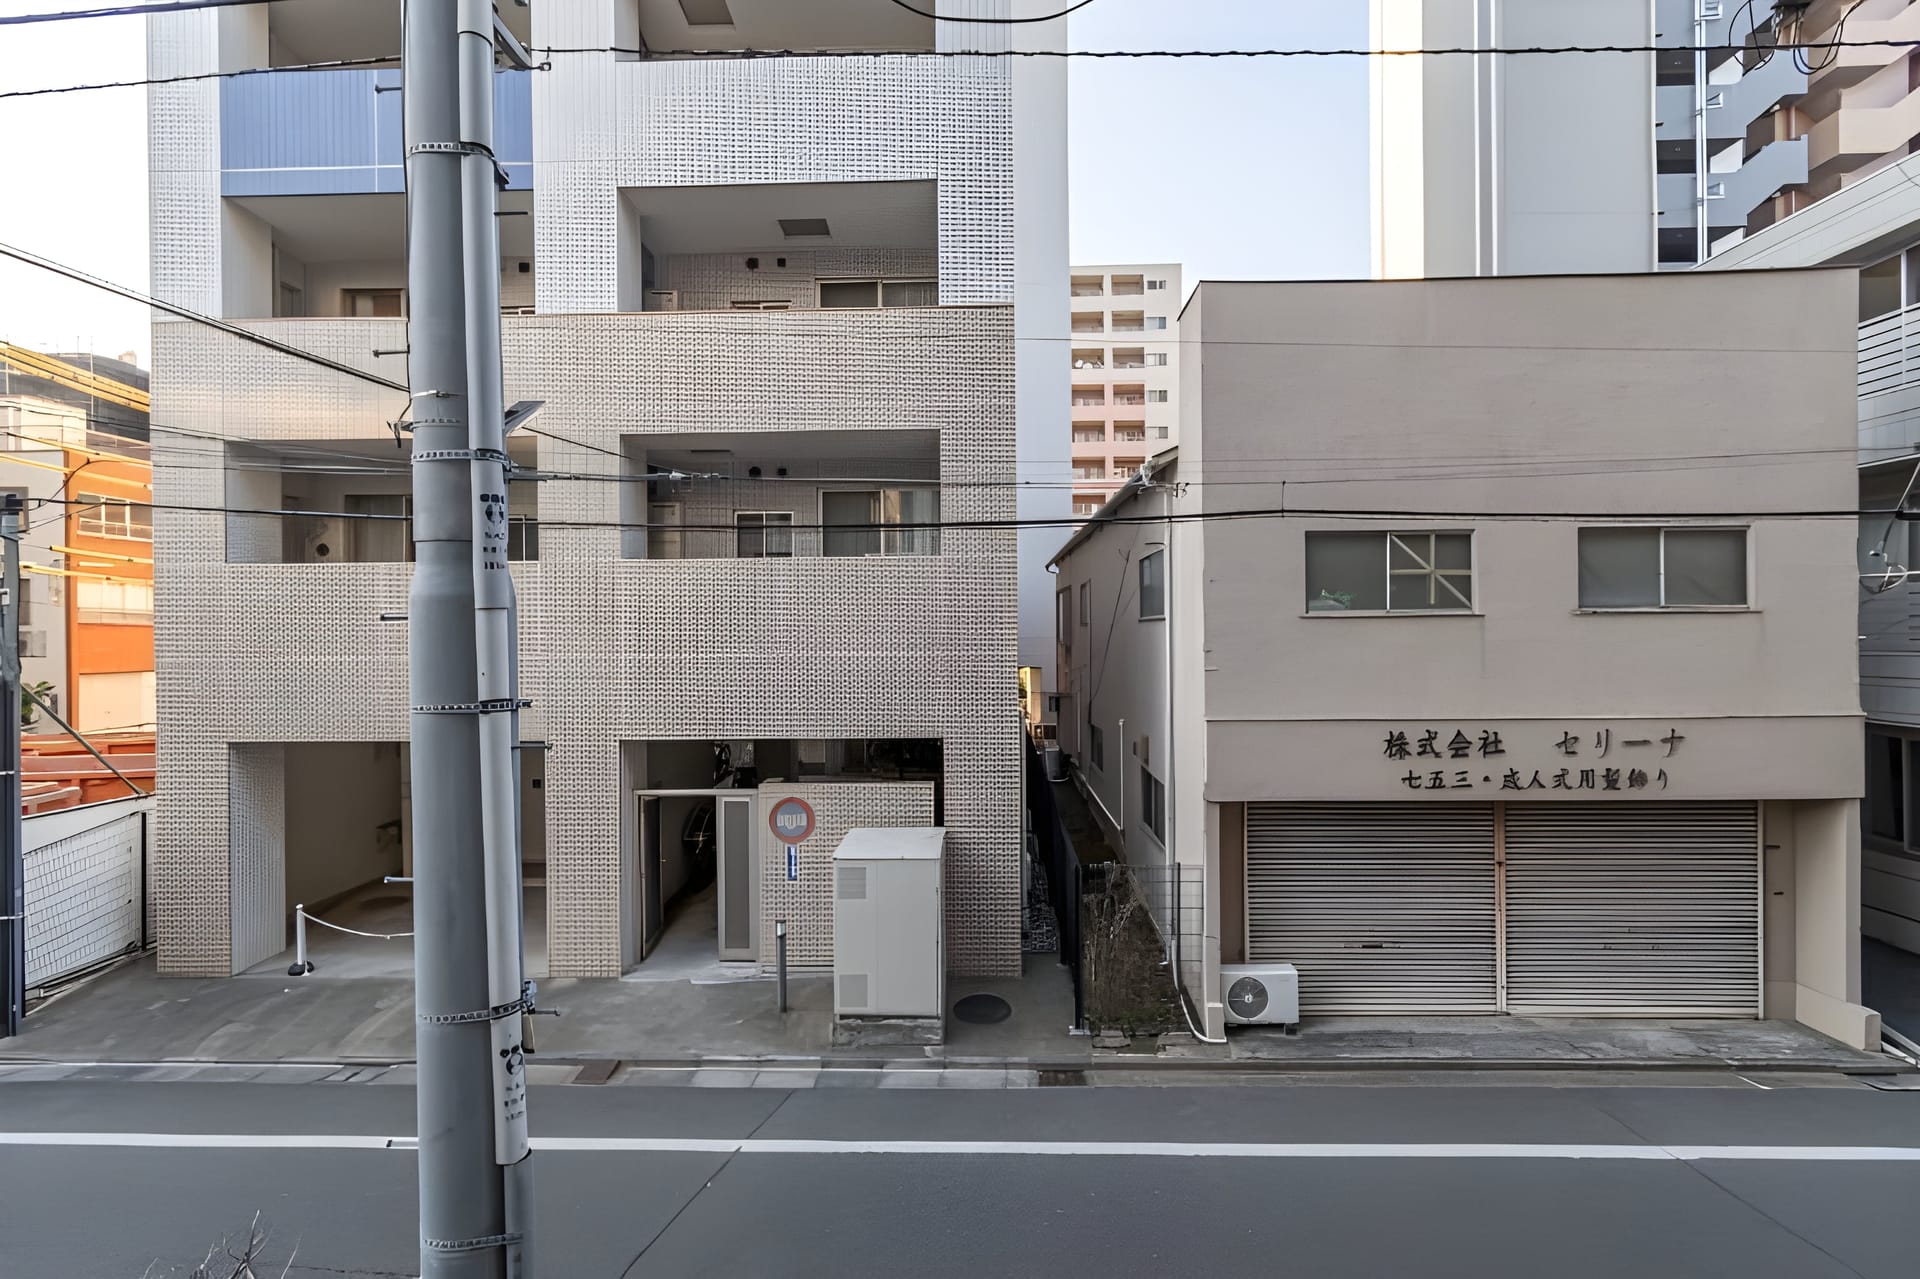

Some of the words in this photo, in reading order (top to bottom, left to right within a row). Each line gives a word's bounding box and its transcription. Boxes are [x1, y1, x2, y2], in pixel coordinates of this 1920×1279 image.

[1384, 729, 1506, 760] 株式会社
[1554, 728, 1686, 758] セリーナ
